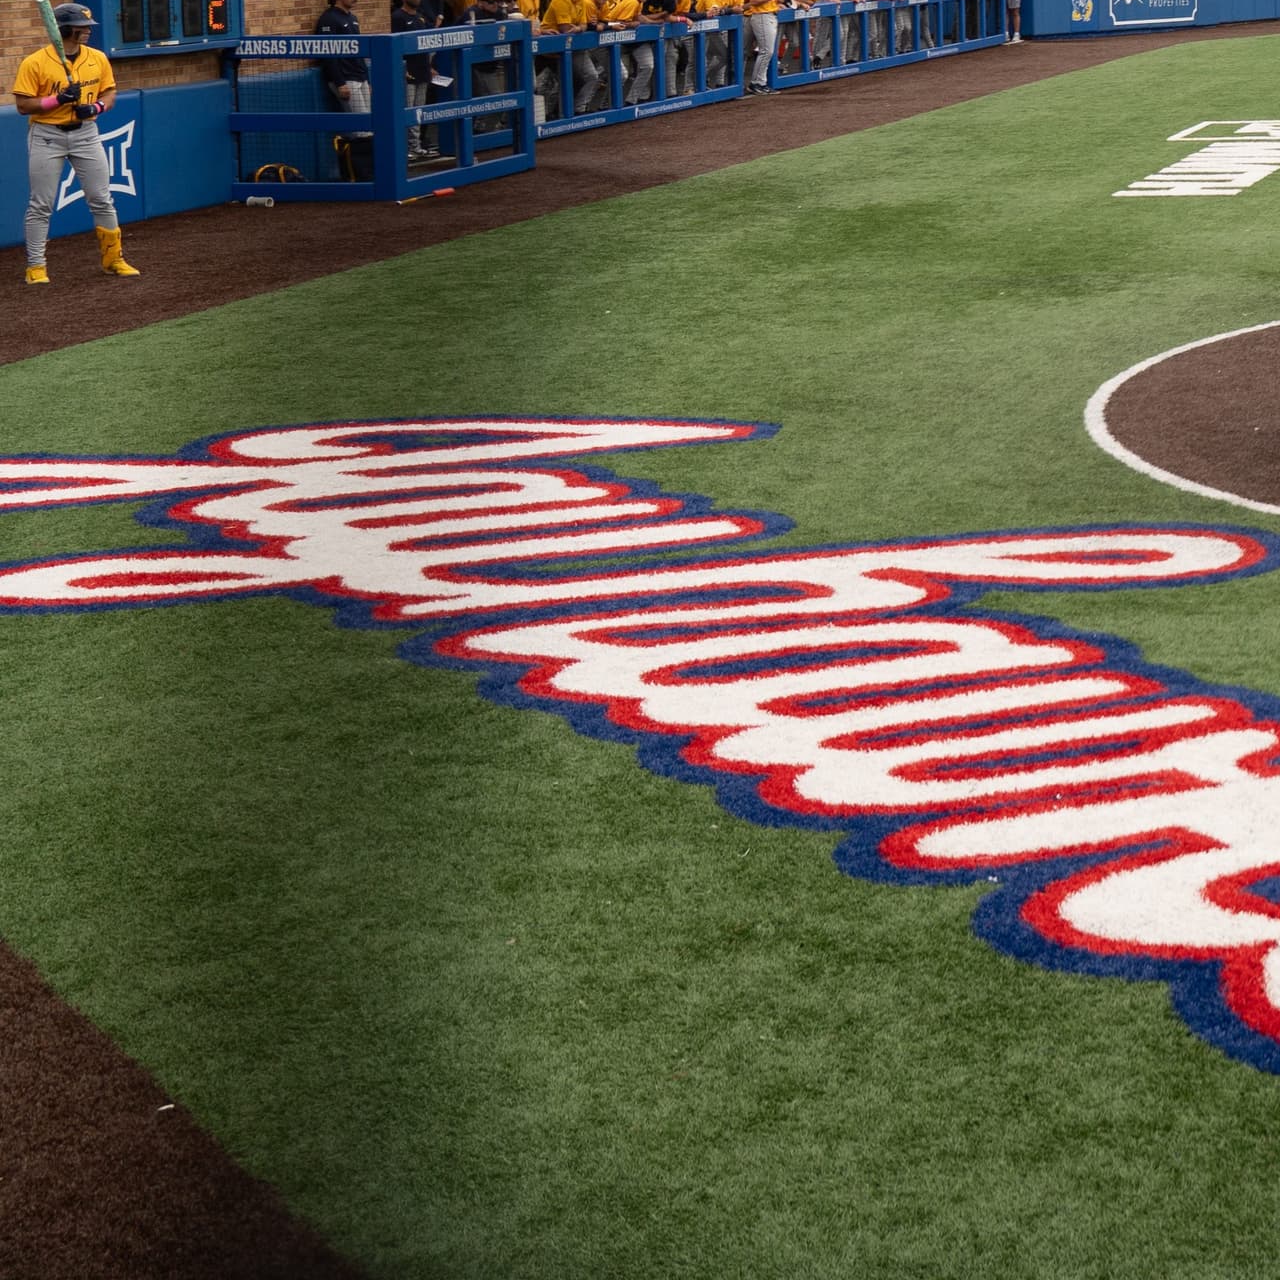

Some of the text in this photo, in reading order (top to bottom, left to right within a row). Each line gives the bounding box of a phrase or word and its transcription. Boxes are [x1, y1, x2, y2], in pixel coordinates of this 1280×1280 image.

[235, 39, 359, 55] KANSAS JAYHAWKS
[416, 30, 474, 50] KANSAS JAYHAWKS
